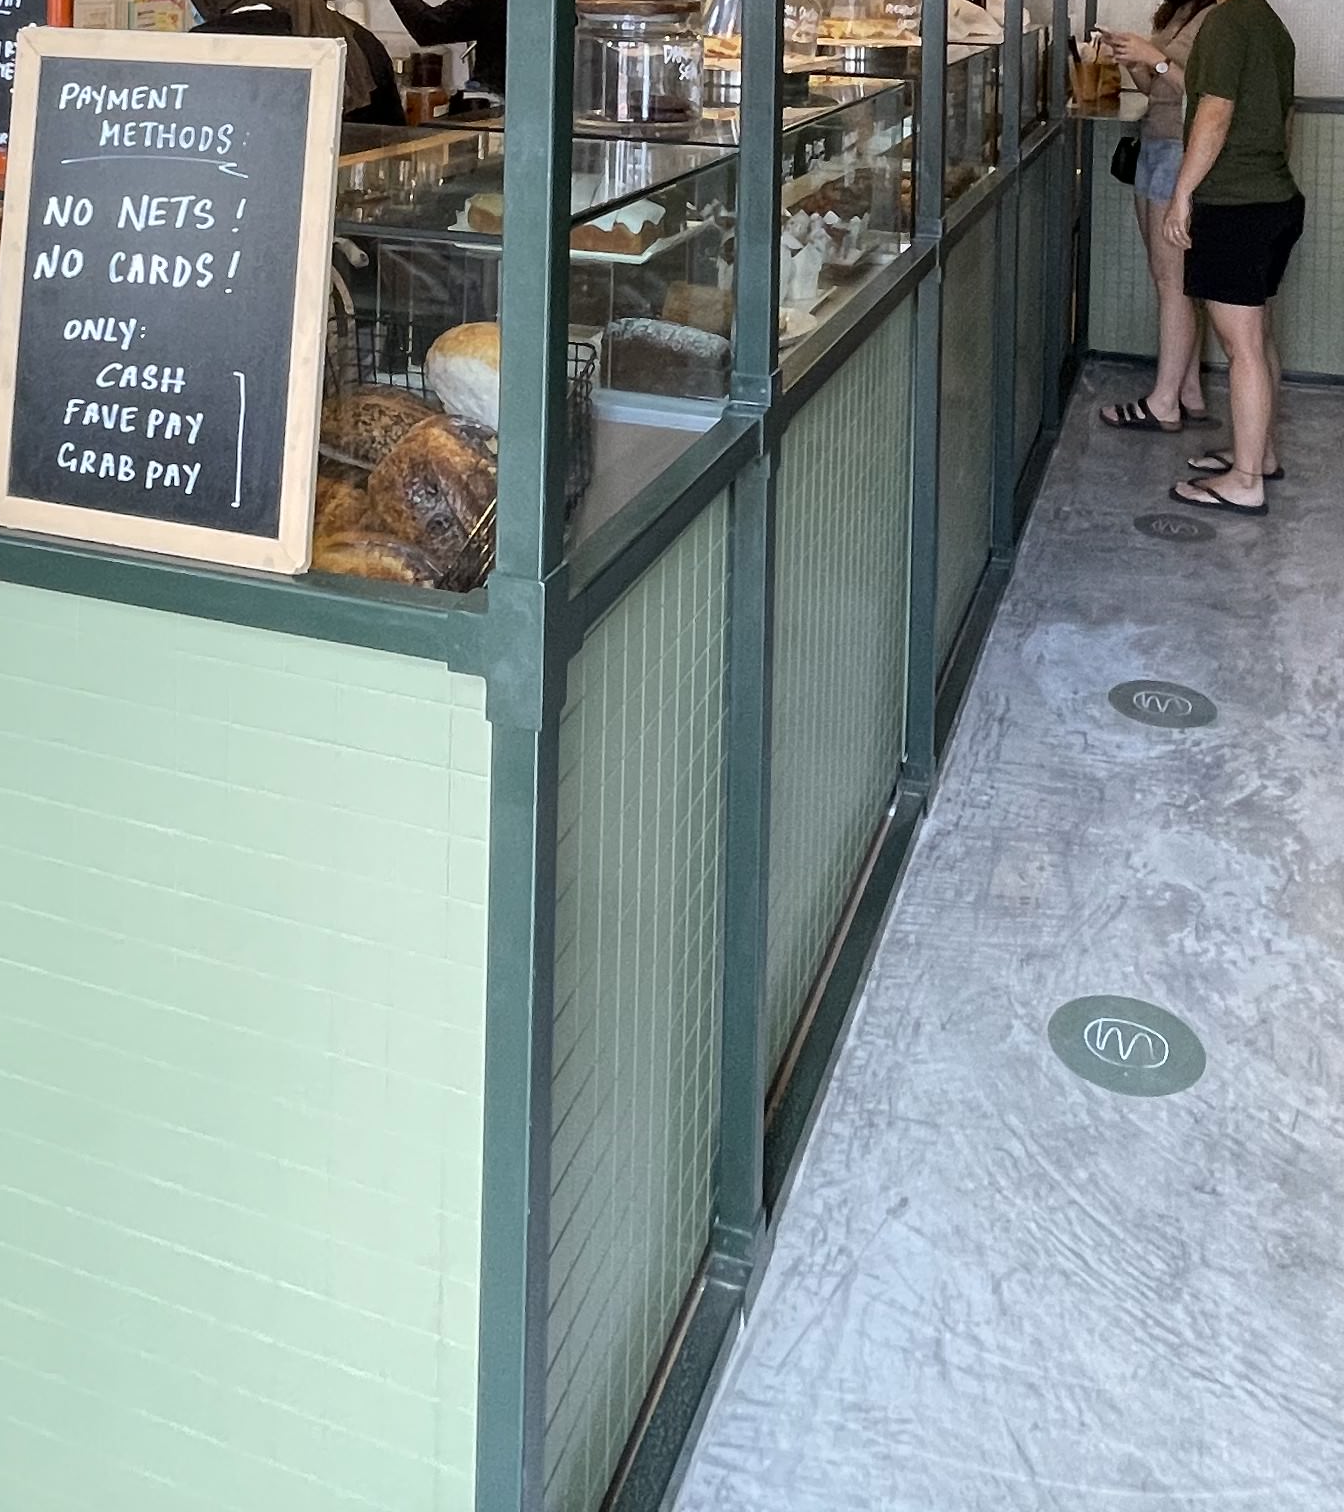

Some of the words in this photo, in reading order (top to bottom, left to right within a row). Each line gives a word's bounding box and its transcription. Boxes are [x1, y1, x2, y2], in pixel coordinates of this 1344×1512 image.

[59, 83, 189, 114] PAYMENT
[43, 195, 93, 227] NO
[33, 245, 84, 280] NO
[109, 250, 241, 293] CARDS!
[63, 318, 147, 350] ONLY:
[96, 362, 186, 393] CASH
[63, 398, 136, 432] FAVE
[146, 409, 204, 444] PAY
[56, 442, 136, 481] GRAB
[145, 461, 201, 495] PAY
